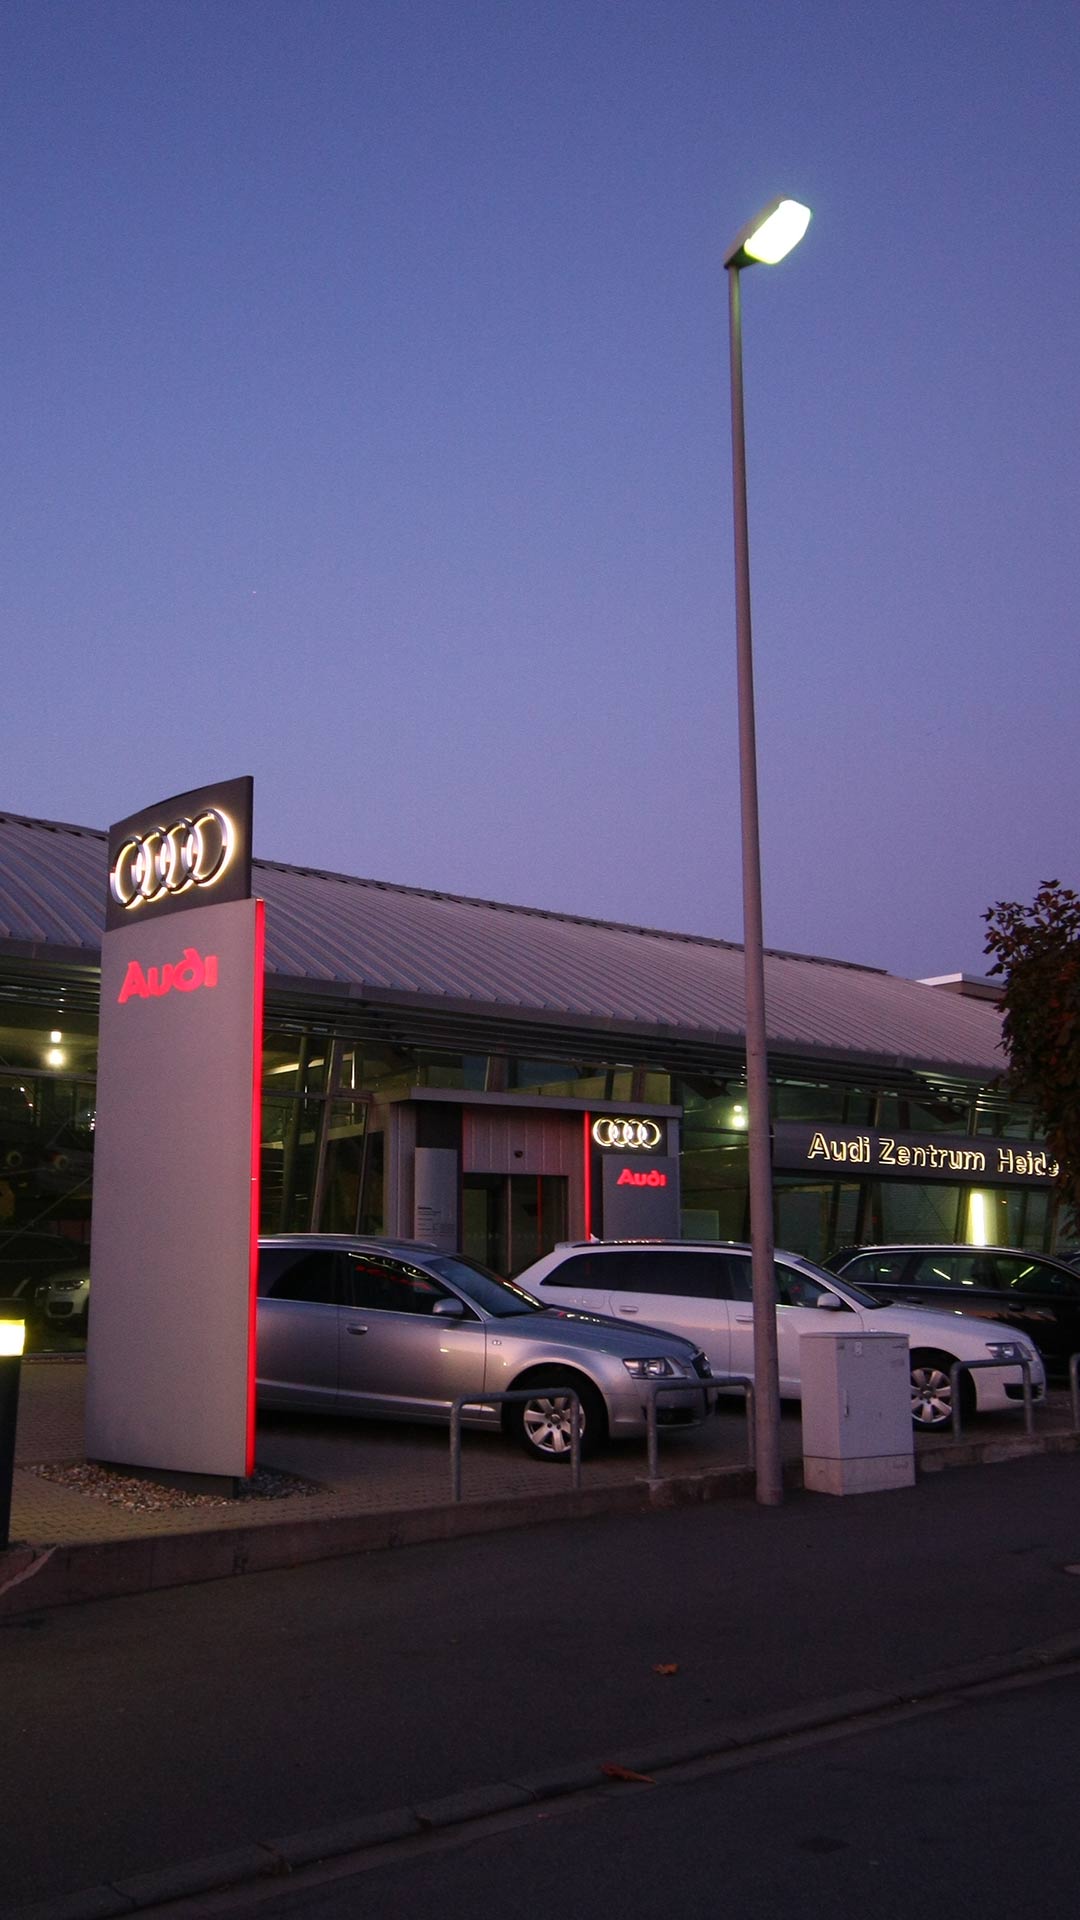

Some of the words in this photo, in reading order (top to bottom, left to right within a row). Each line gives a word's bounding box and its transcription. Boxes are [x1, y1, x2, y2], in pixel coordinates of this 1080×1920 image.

[117, 947, 219, 1004] Audi
[807, 1132, 871, 1163] Audi
[878, 1137, 986, 1171] Zentrum
[616, 1167, 668, 1188] Audi
